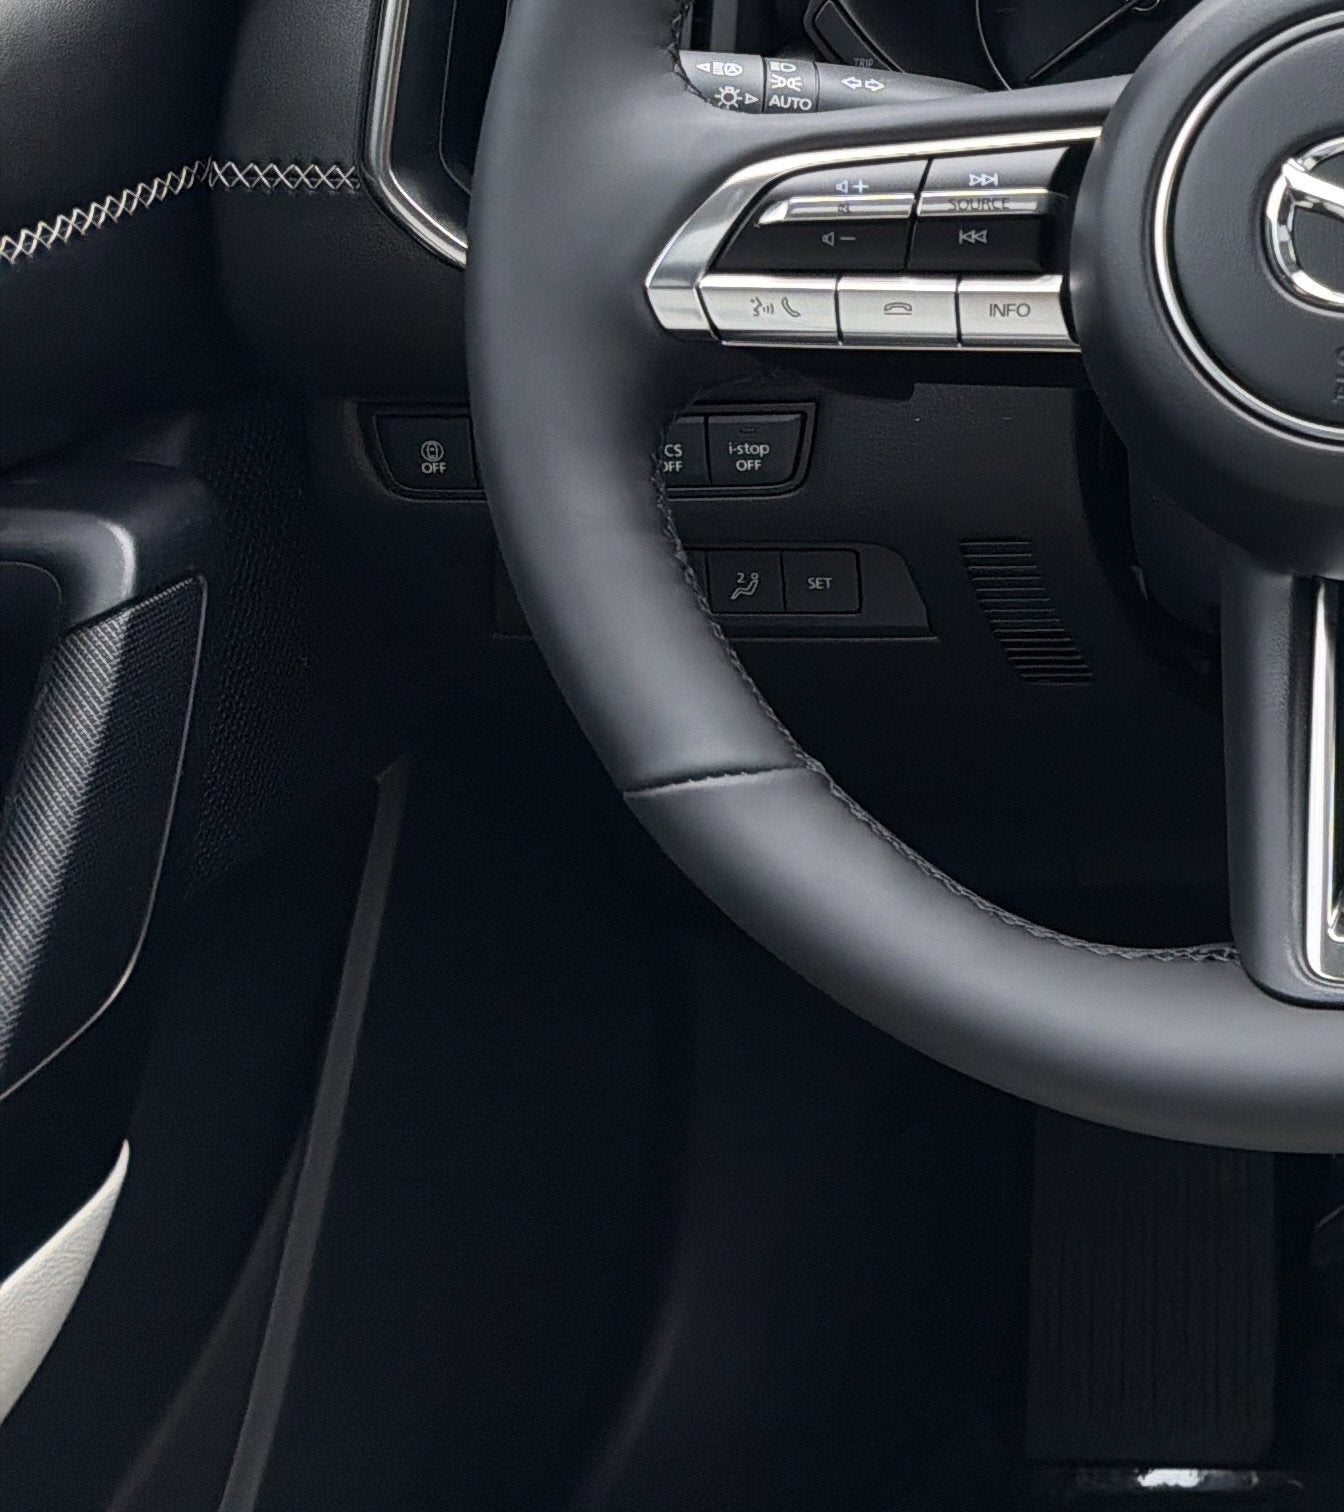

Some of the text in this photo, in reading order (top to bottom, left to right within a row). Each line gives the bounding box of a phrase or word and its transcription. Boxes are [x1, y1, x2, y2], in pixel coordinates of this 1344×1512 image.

[853, 57, 875, 69] TRIP
[768, 94, 812, 111] AUTO
[947, 197, 1010, 212] SOURCE
[988, 302, 1031, 318] INFO
[728, 442, 770, 456] i-stop
[421, 462, 447, 474] OFF
[735, 459, 762, 472] OFF
[736, 572, 745, 584] 2
[807, 577, 832, 590] SET
